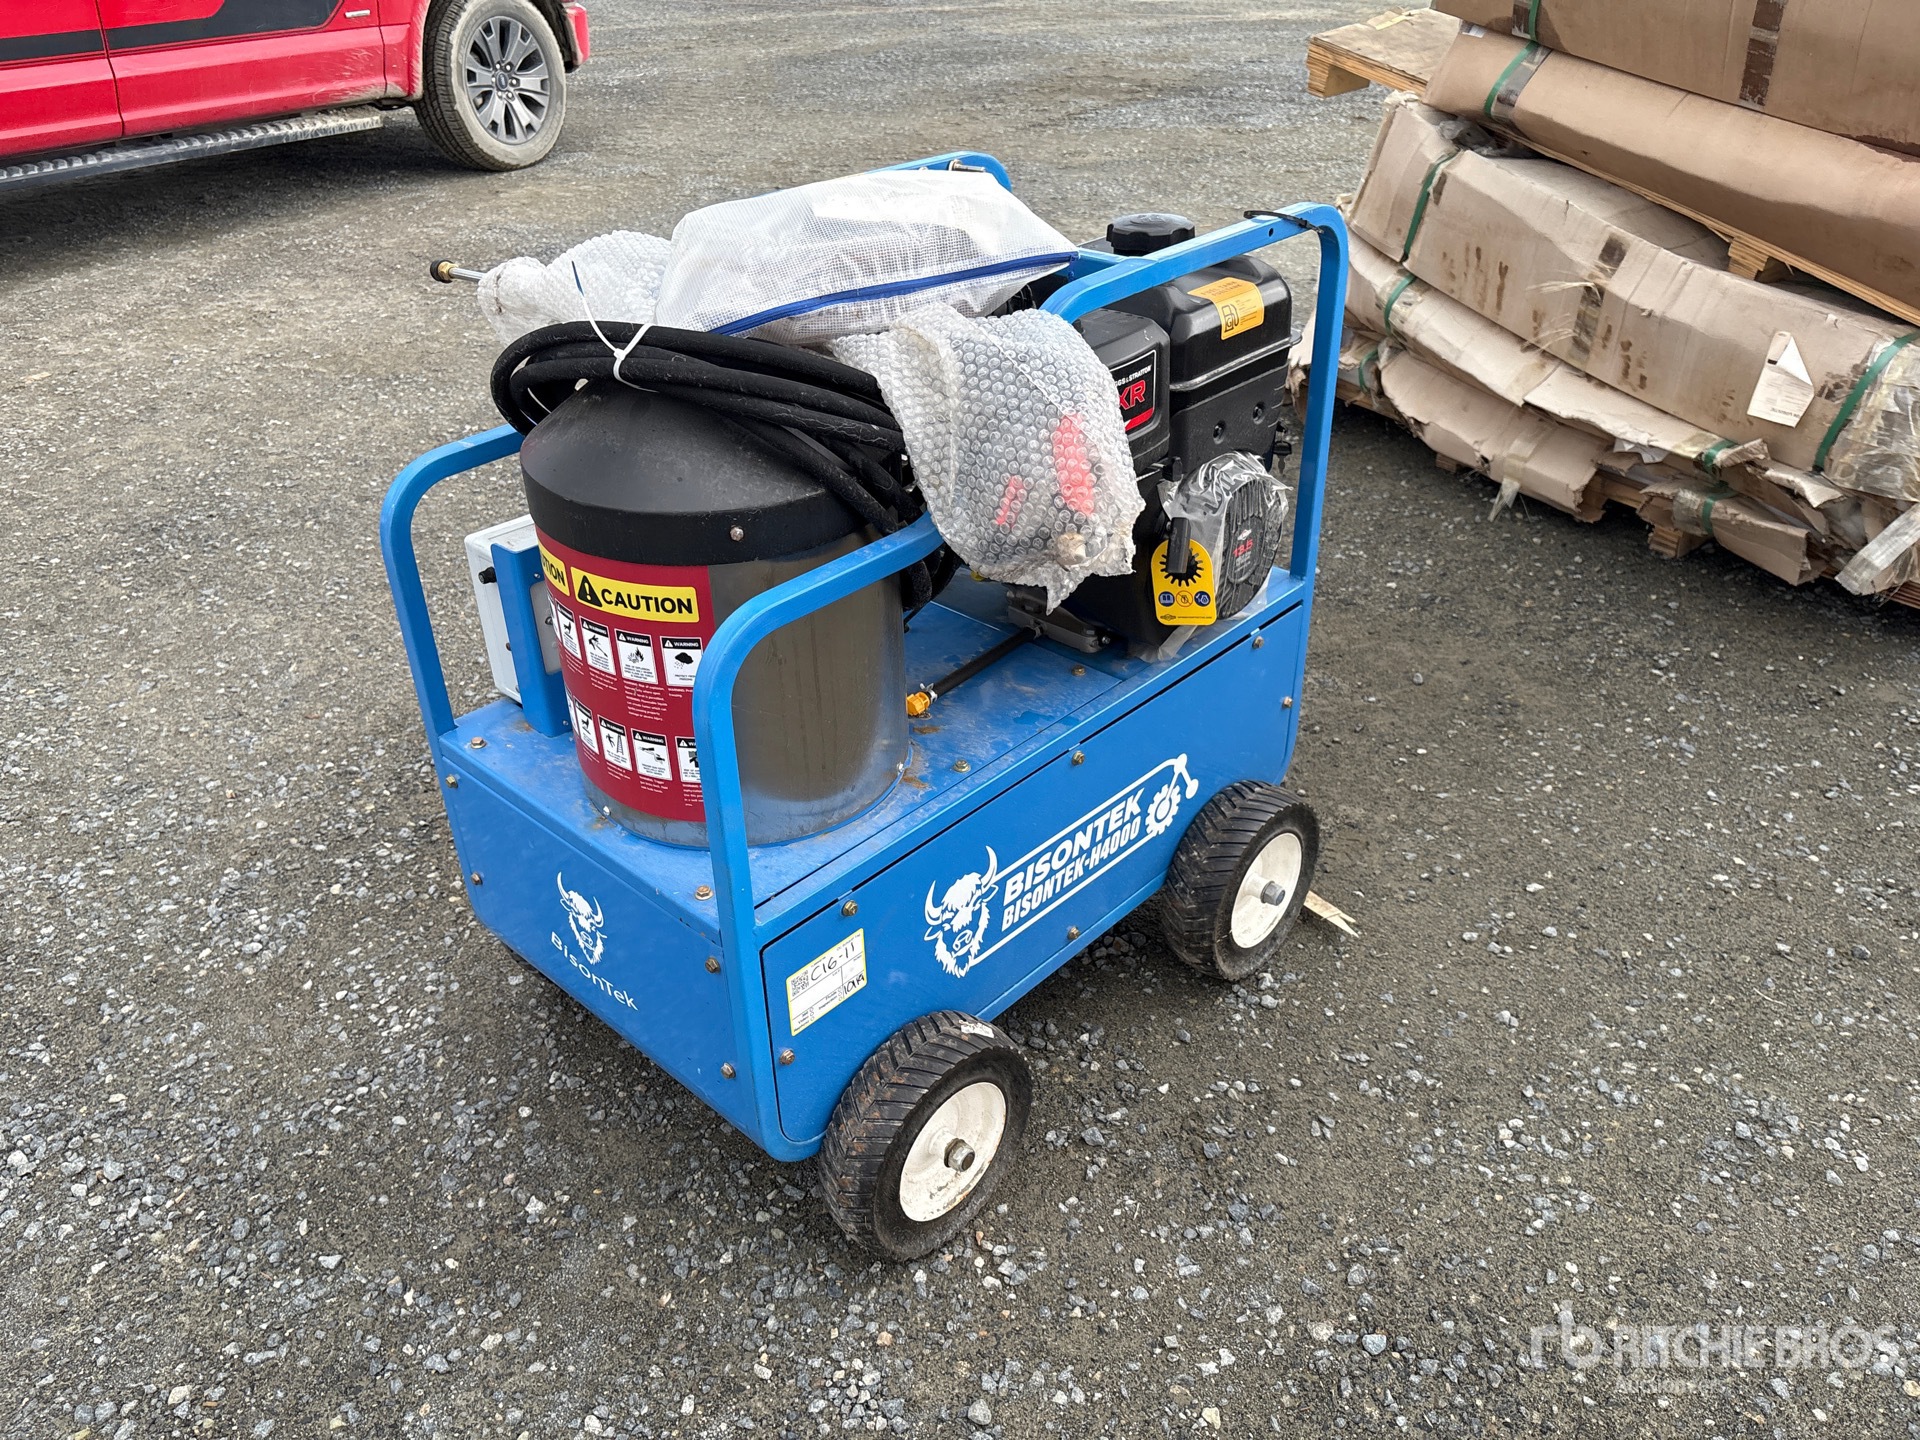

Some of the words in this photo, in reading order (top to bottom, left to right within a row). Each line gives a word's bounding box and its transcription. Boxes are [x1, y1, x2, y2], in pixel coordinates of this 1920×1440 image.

[601, 588, 693, 615] CAUTION
[1001, 815, 1142, 932] BISONTEK-H4000
[1003, 787, 1146, 907] BISONTEK
[551, 931, 638, 1011] BisonTek
